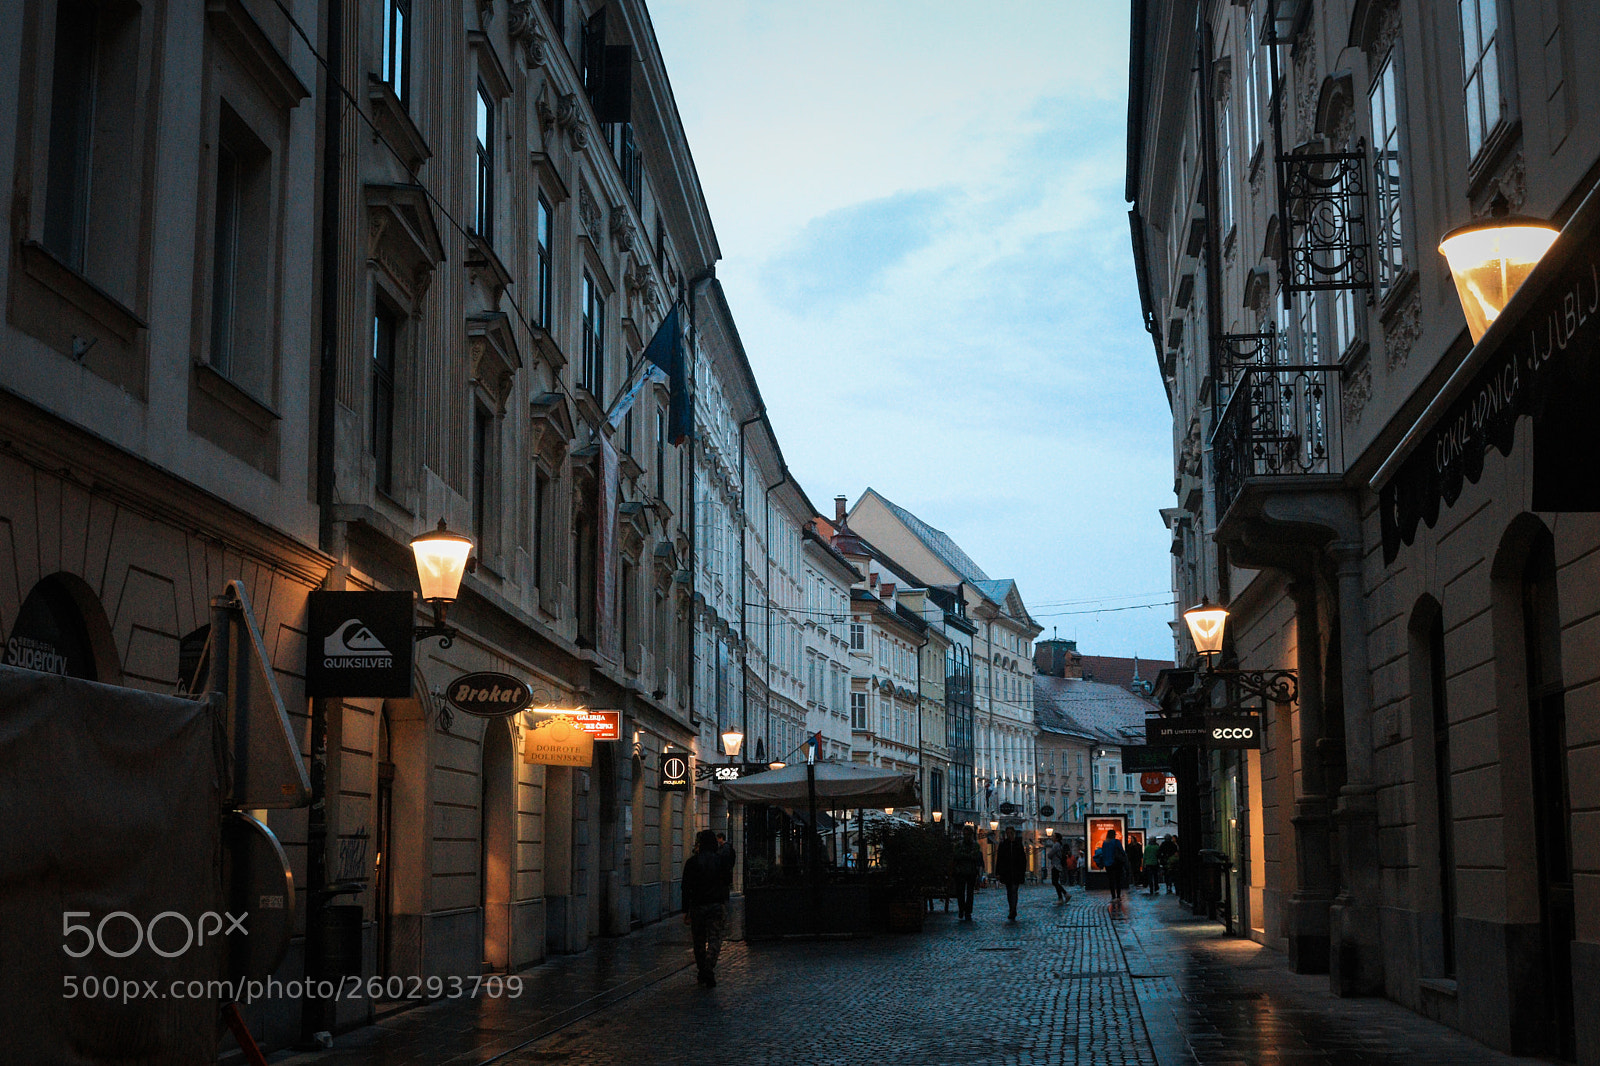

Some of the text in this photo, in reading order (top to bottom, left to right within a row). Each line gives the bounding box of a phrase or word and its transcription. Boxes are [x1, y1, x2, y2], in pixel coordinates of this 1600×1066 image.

[323, 657, 393, 669] QUIKSILVER
[455, 684, 523, 704] Brokat
[1212, 728, 1253, 739] ecco
[536, 745, 581, 753] DOBROTE
[531, 752, 585, 762] DOLENJSKE
